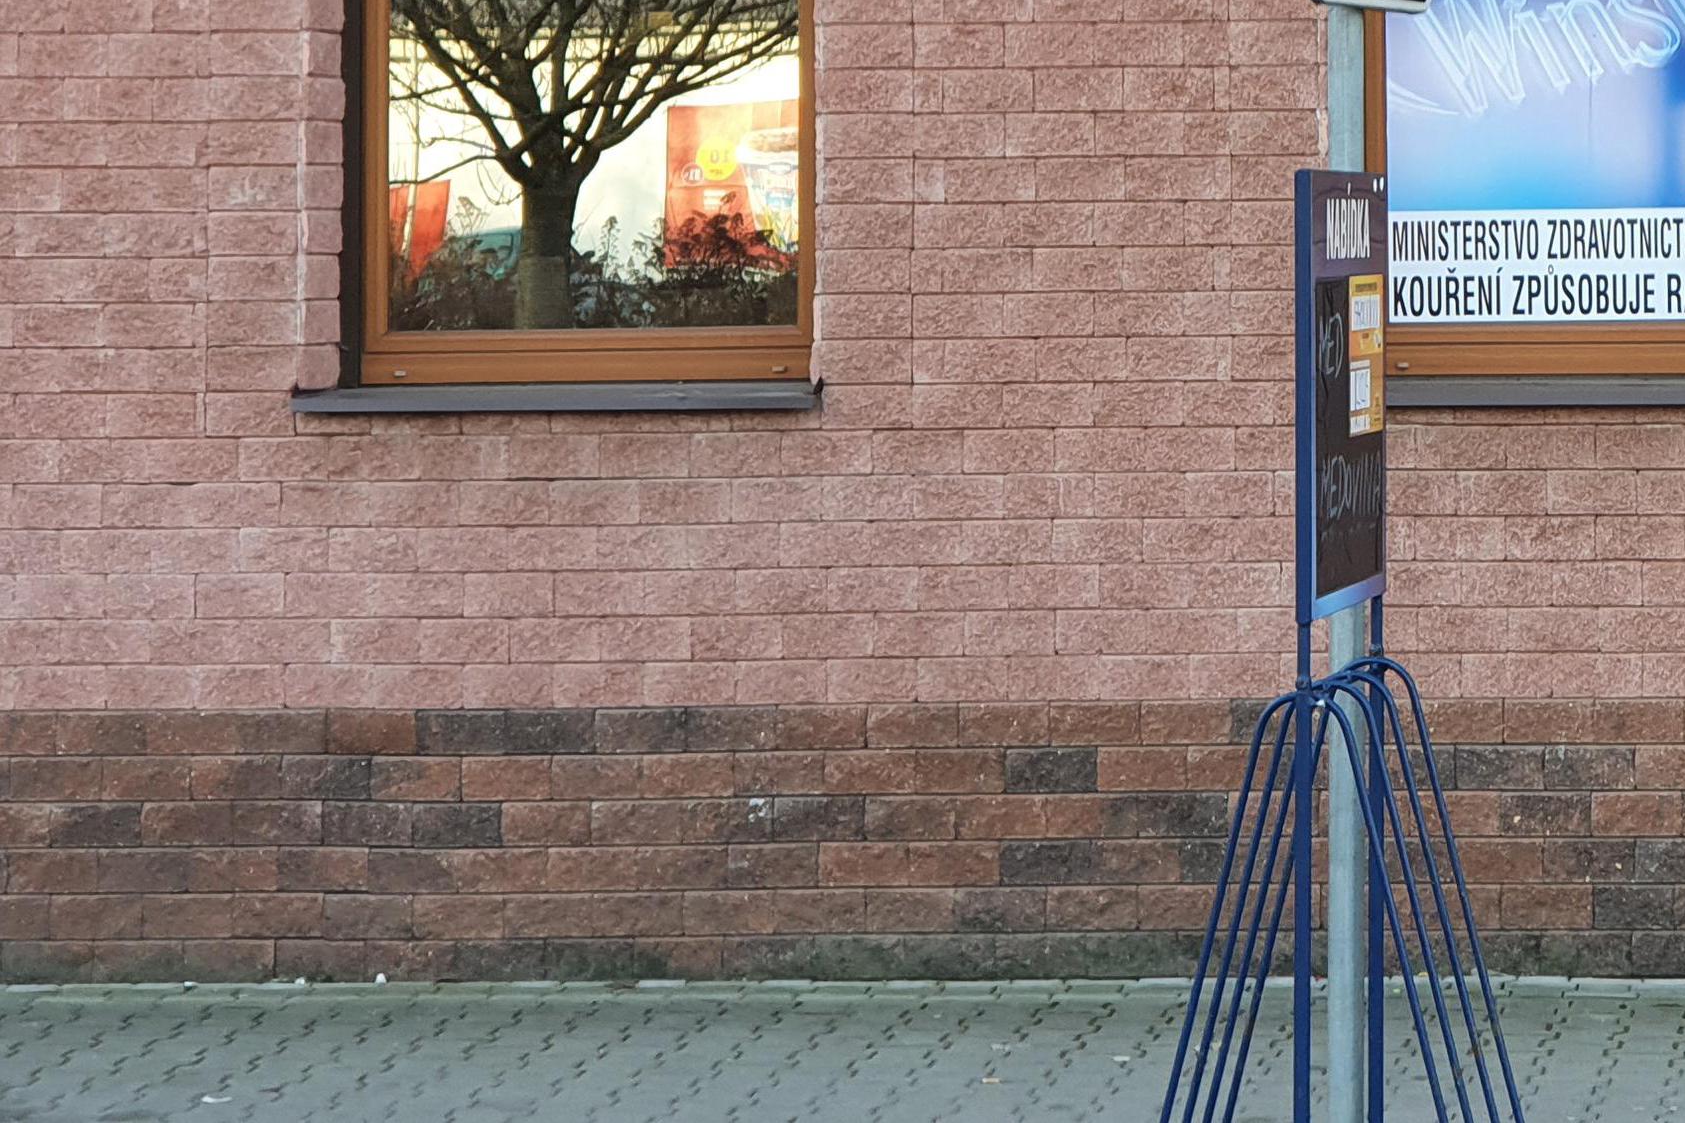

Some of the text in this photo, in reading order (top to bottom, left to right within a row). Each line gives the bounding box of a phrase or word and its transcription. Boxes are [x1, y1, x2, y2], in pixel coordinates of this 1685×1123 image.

[1326, 182, 1370, 260] NABÍDKA
[1392, 219, 1539, 262] MINISTERSTVO
[1393, 266, 1503, 317] KOUŘENÍ
[1511, 264, 1656, 316] ZPŮSOBUJE
